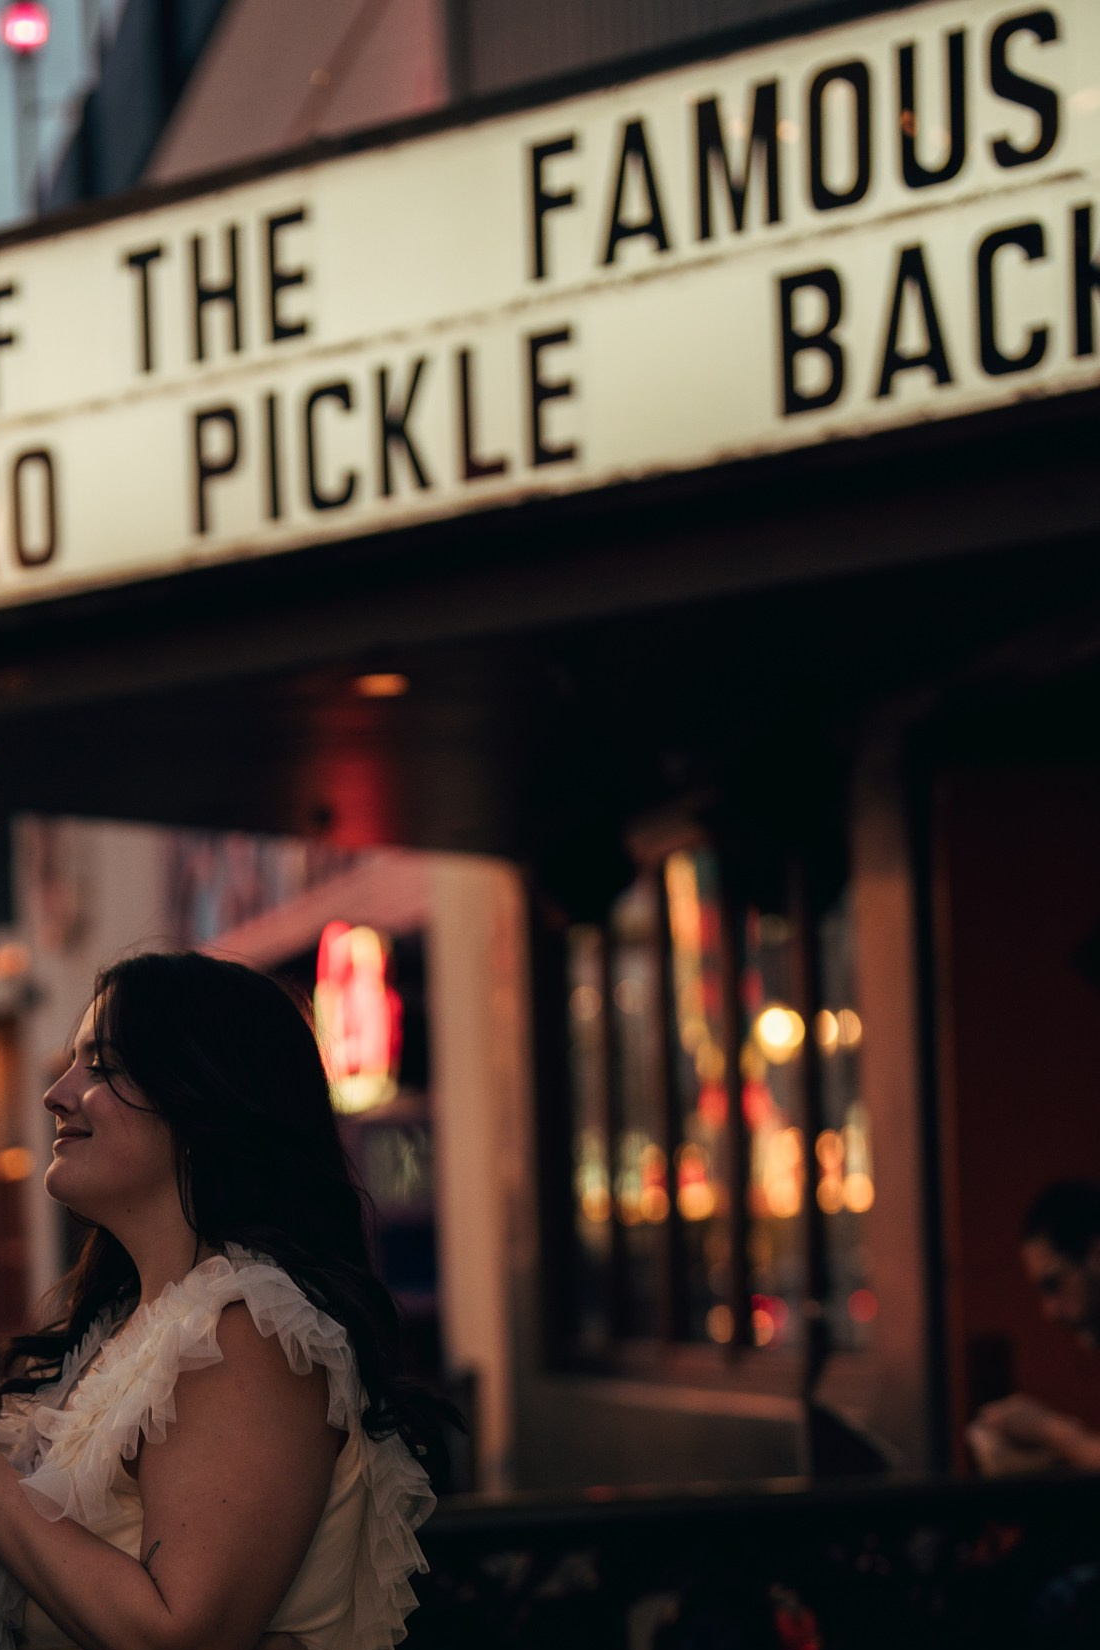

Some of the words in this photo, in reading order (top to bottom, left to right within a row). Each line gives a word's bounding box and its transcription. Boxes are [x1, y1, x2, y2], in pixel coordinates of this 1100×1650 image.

[127, 206, 307, 372] THE
[530, 11, 1058, 280] FAMOUS
[196, 327, 576, 534] PICKLE
